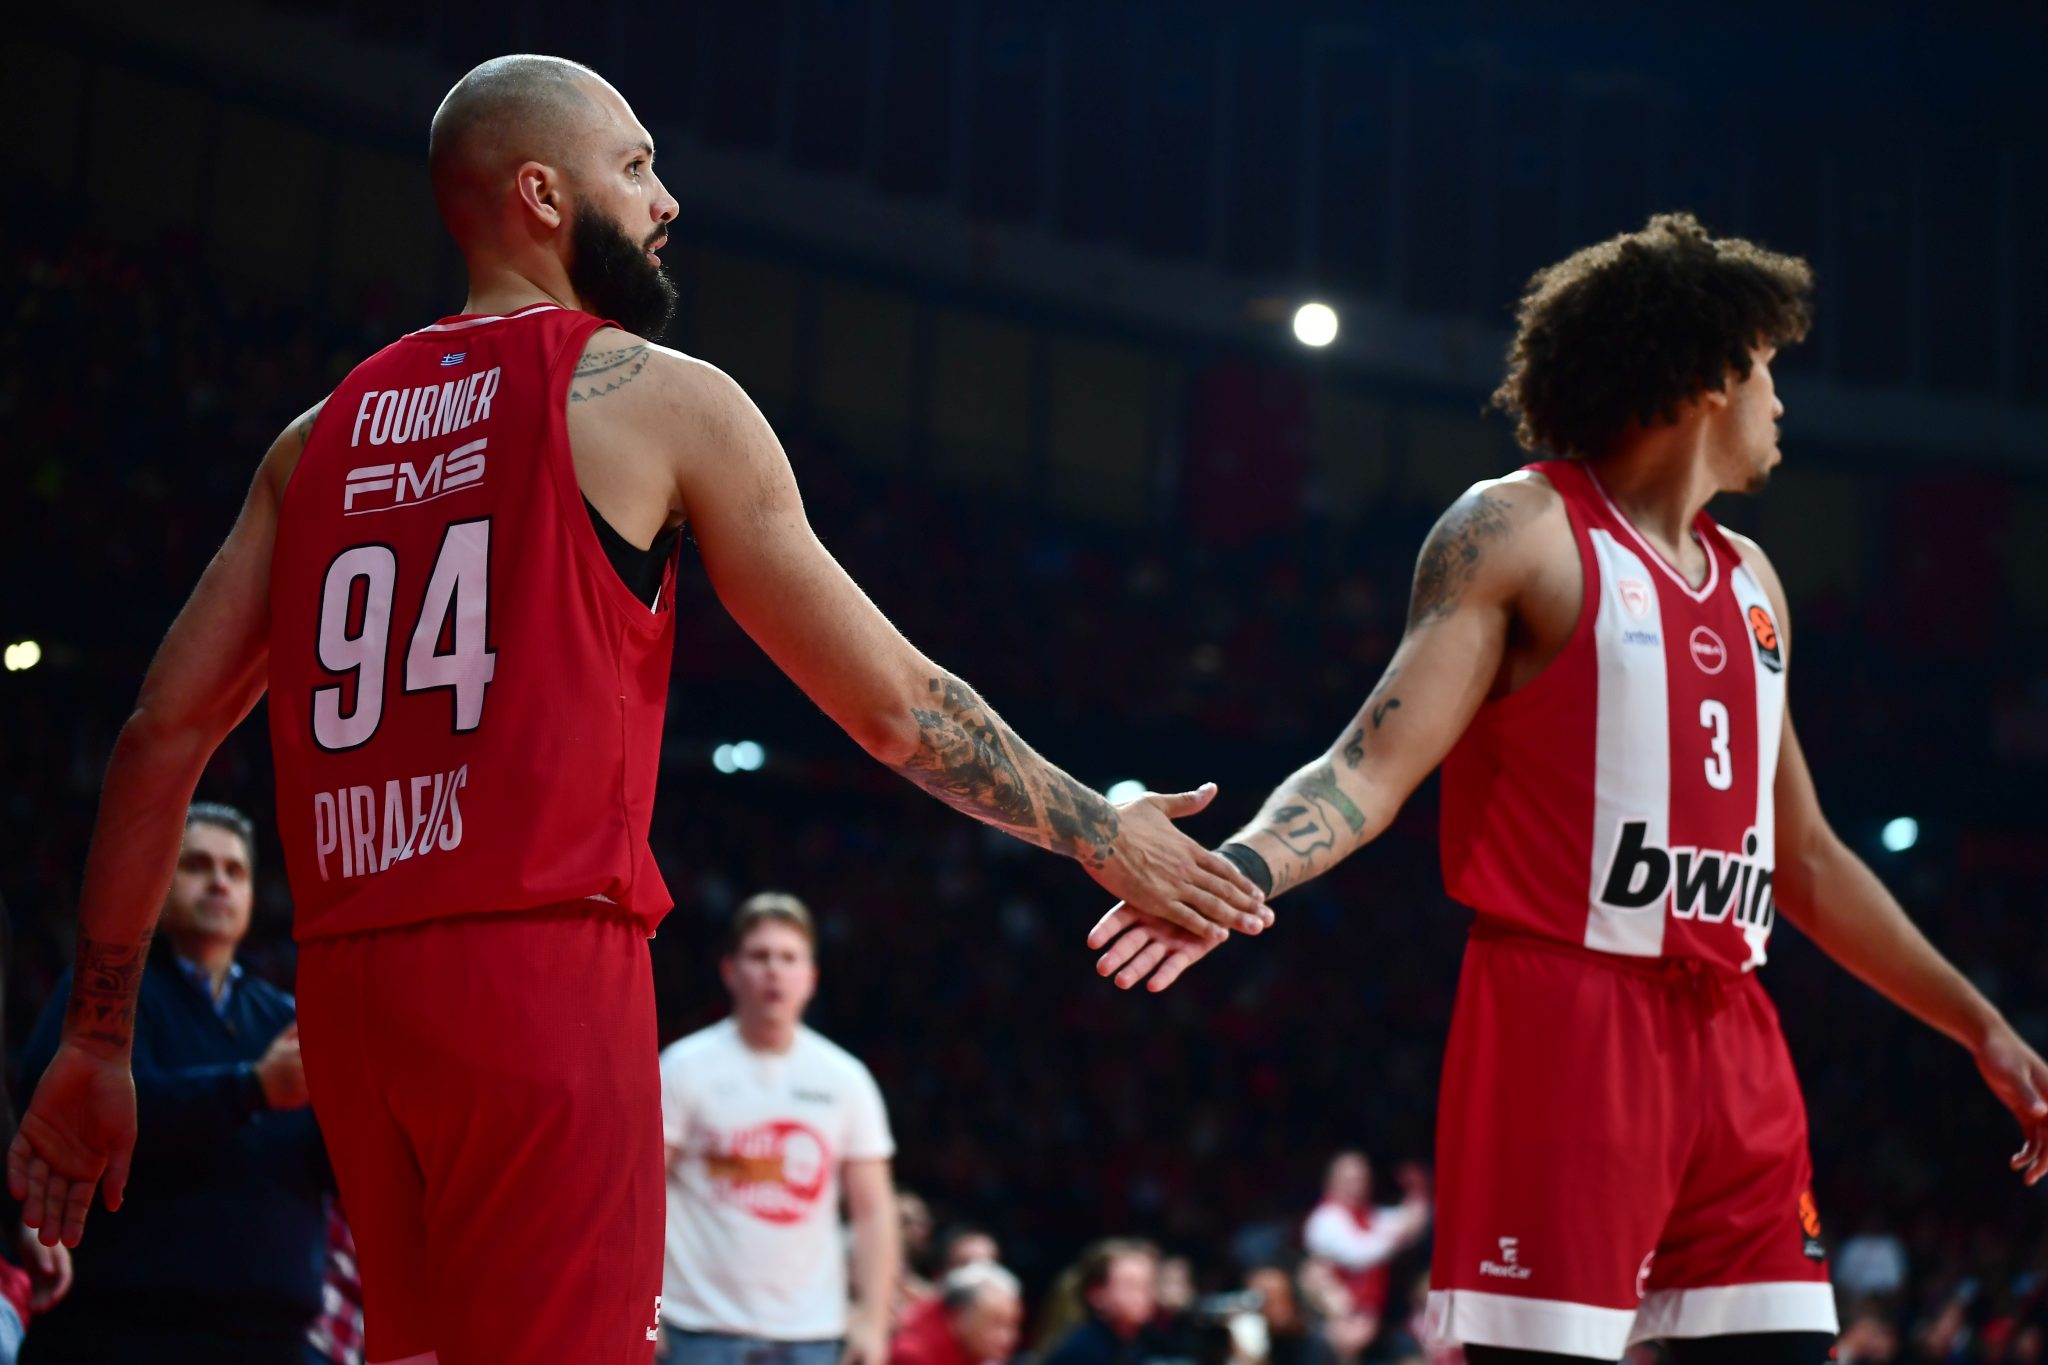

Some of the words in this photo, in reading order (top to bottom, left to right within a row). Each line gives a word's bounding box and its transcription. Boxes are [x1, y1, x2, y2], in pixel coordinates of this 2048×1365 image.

[351, 366, 502, 448] FOURNIER
[343, 438, 488, 513] FMS
[311, 516, 496, 752] 94
[1698, 698, 1733, 791] 3
[314, 764, 468, 882] PIRAEUS
[1601, 821, 1775, 928] bwin
